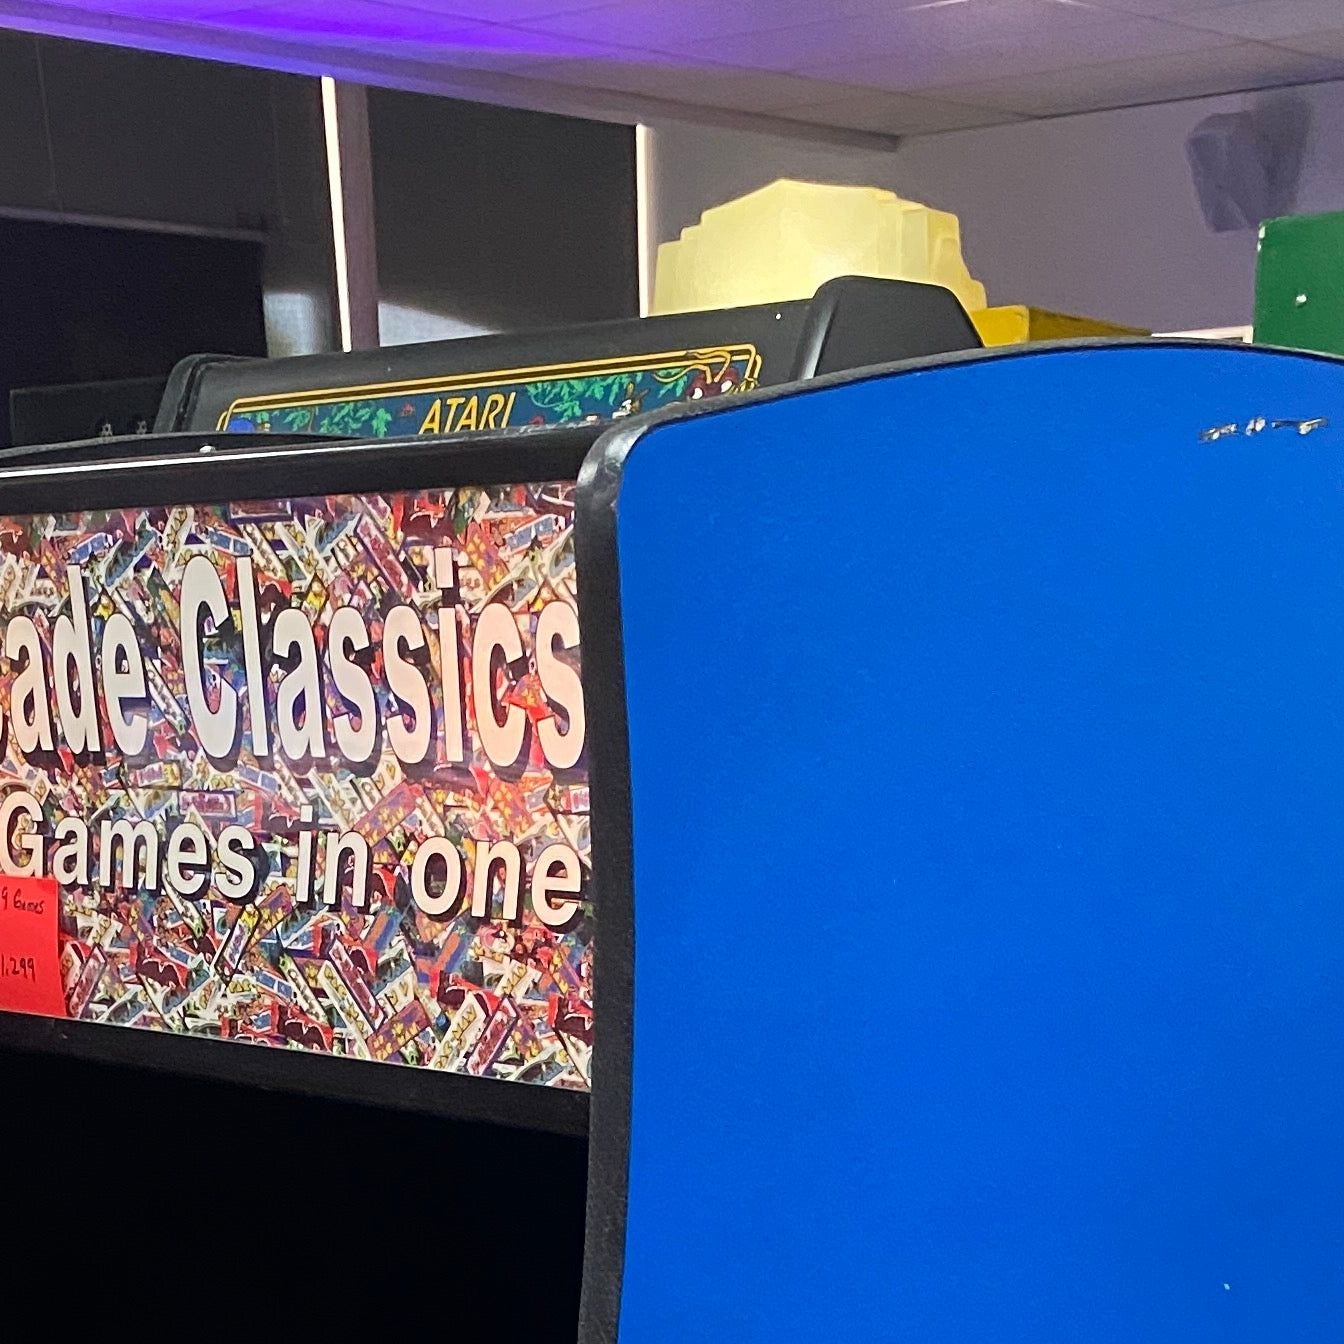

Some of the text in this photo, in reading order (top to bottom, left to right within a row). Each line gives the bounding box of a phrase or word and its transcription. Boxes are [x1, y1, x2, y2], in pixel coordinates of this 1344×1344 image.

[418, 392, 516, 434] ATARI
[181, 546, 586, 770] Classics
[296, 805, 367, 907] in
[412, 836, 582, 927] one
